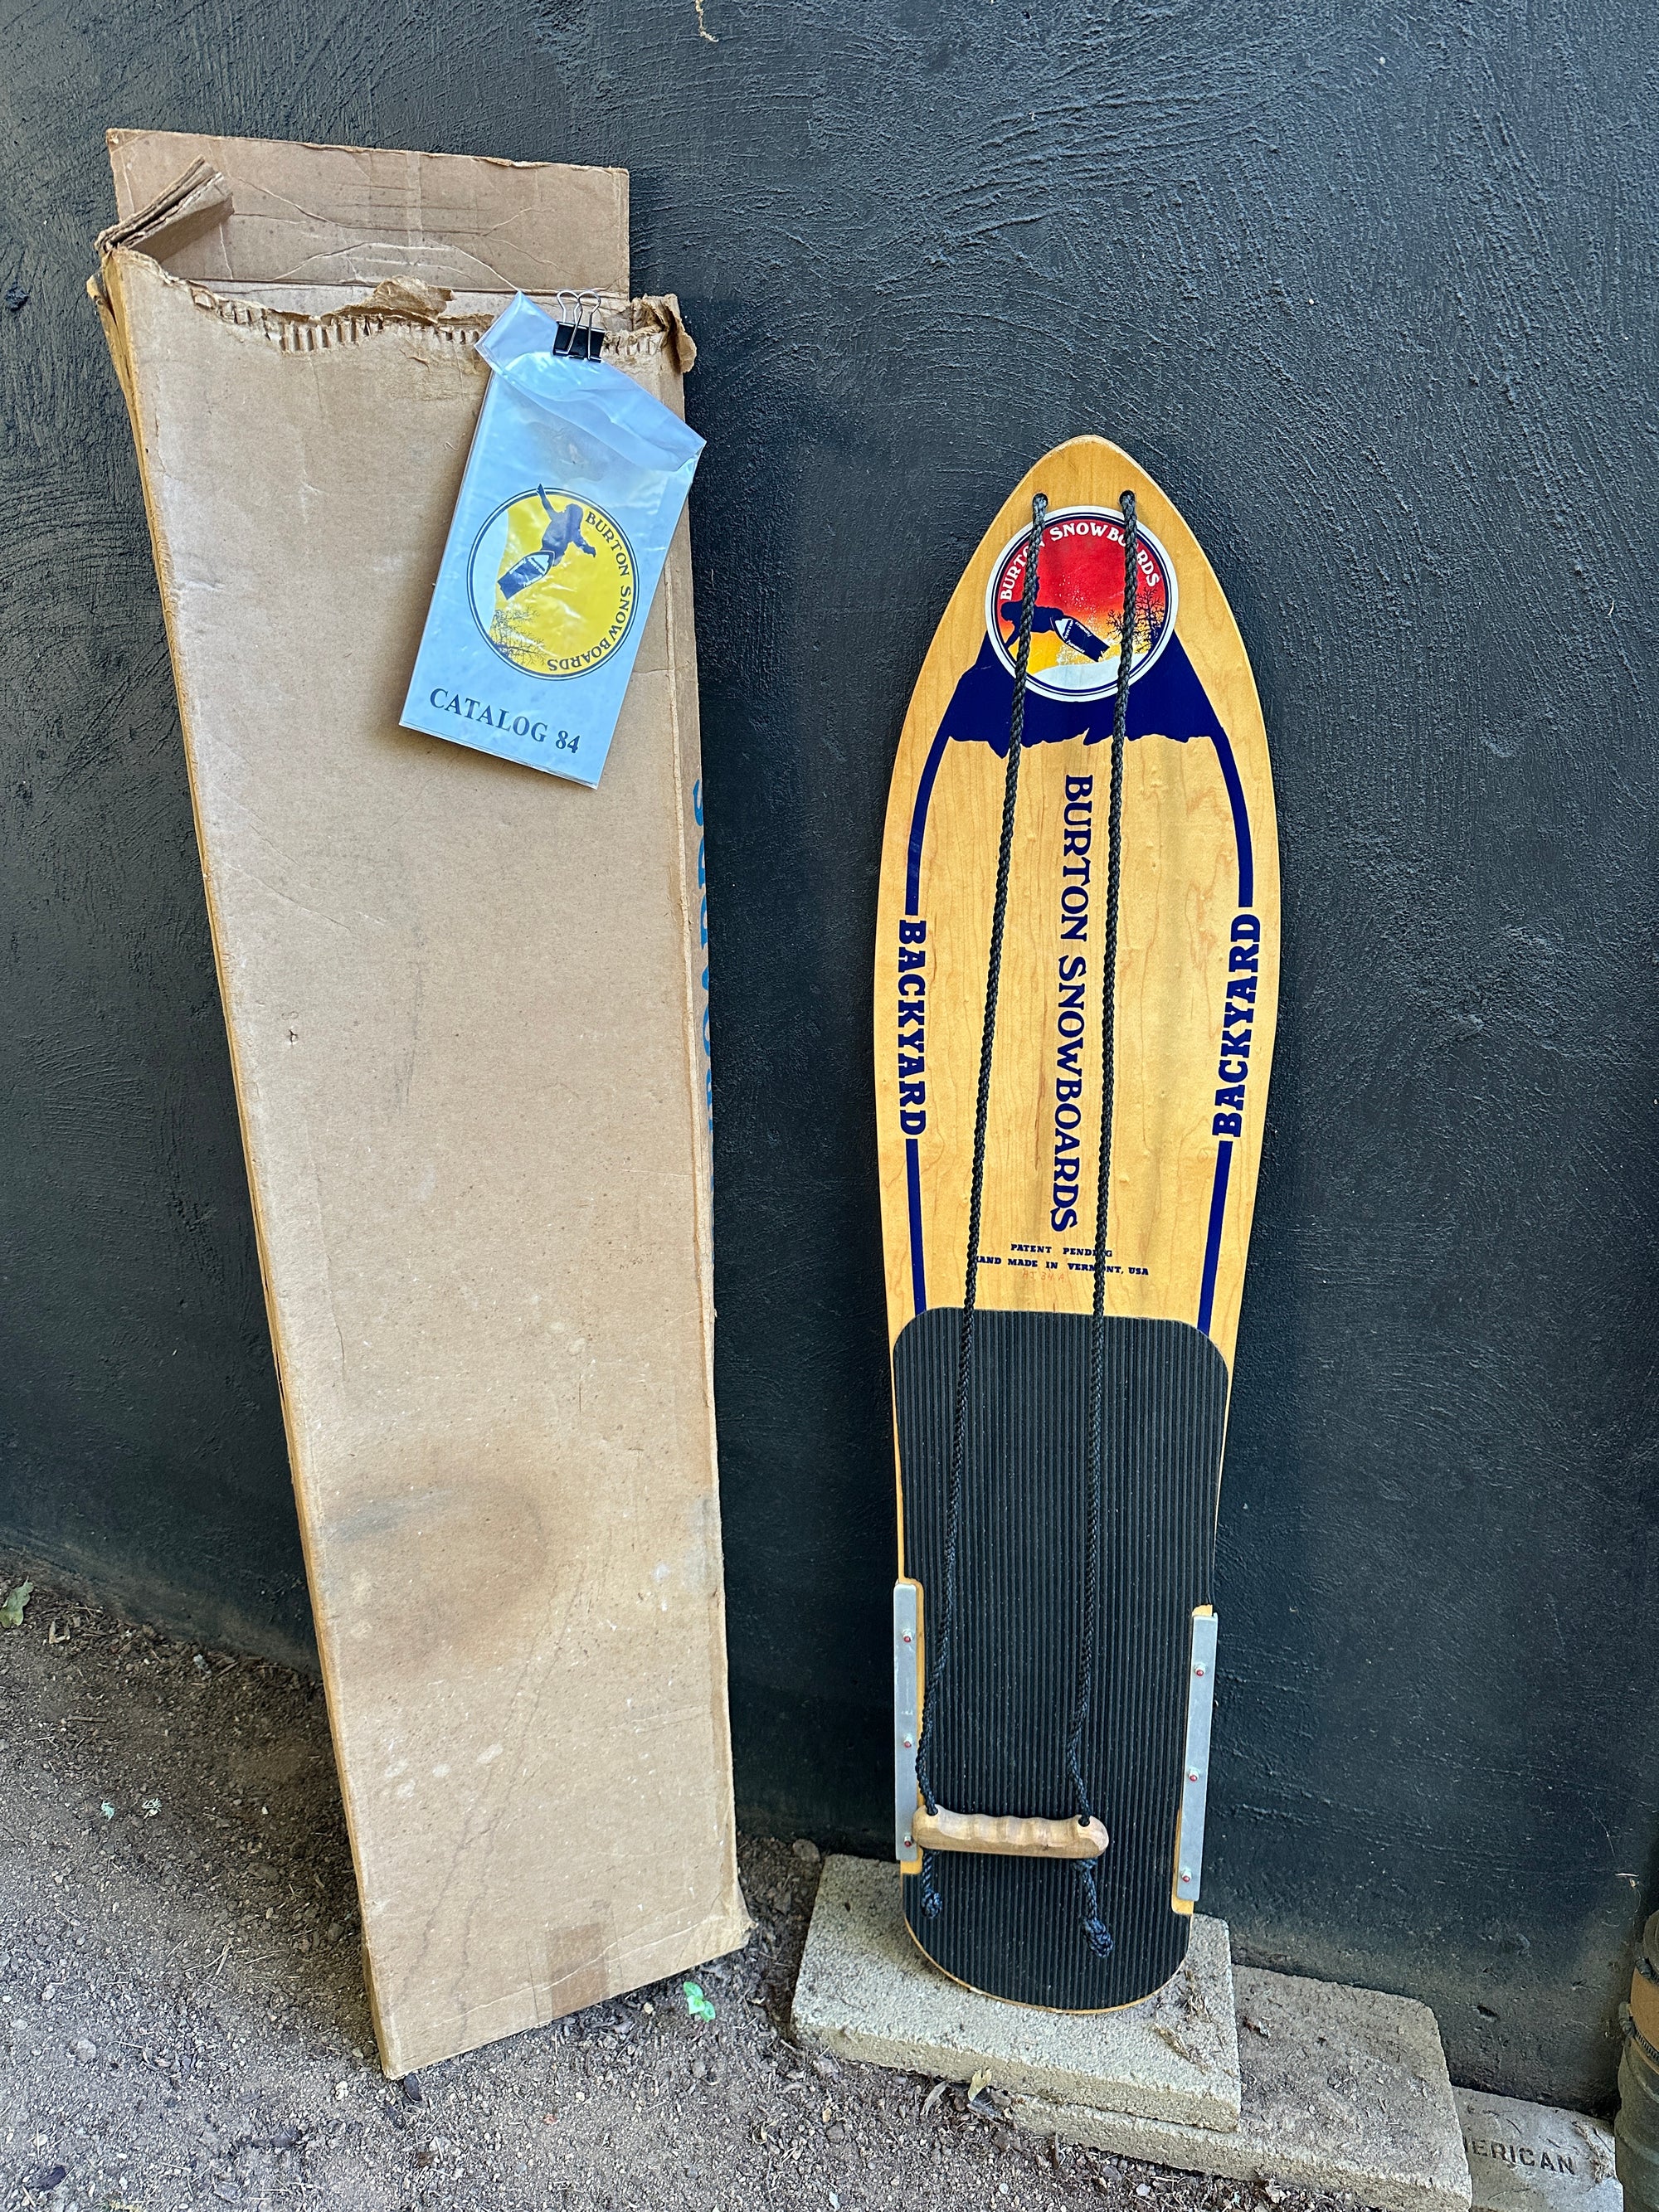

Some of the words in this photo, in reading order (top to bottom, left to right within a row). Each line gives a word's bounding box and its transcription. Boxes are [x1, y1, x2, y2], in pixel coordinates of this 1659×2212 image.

[586, 511, 630, 576] BURTON
[1000, 535, 1045, 600] BURT
[1049, 522, 1160, 587] SNOWBORDS
[429, 688, 548, 743] CATALOG
[555, 730, 581, 754] 84
[1061, 774, 1093, 942] BURTON
[898, 919, 927, 1135] BACKYARD
[1212, 913, 1261, 1138] BACKYARD
[1049, 955, 1087, 1232] SNOWBOARDS
[1007, 1258, 1039, 1268] MADE
[1045, 1261, 1058, 1270] IN
[1067, 1262, 1125, 1275] VERMNT,
[1128, 1266, 1150, 1276] USA
[1010, 1243, 1053, 1254] PATENT
[1063, 1247, 1113, 1257] PENDIG
